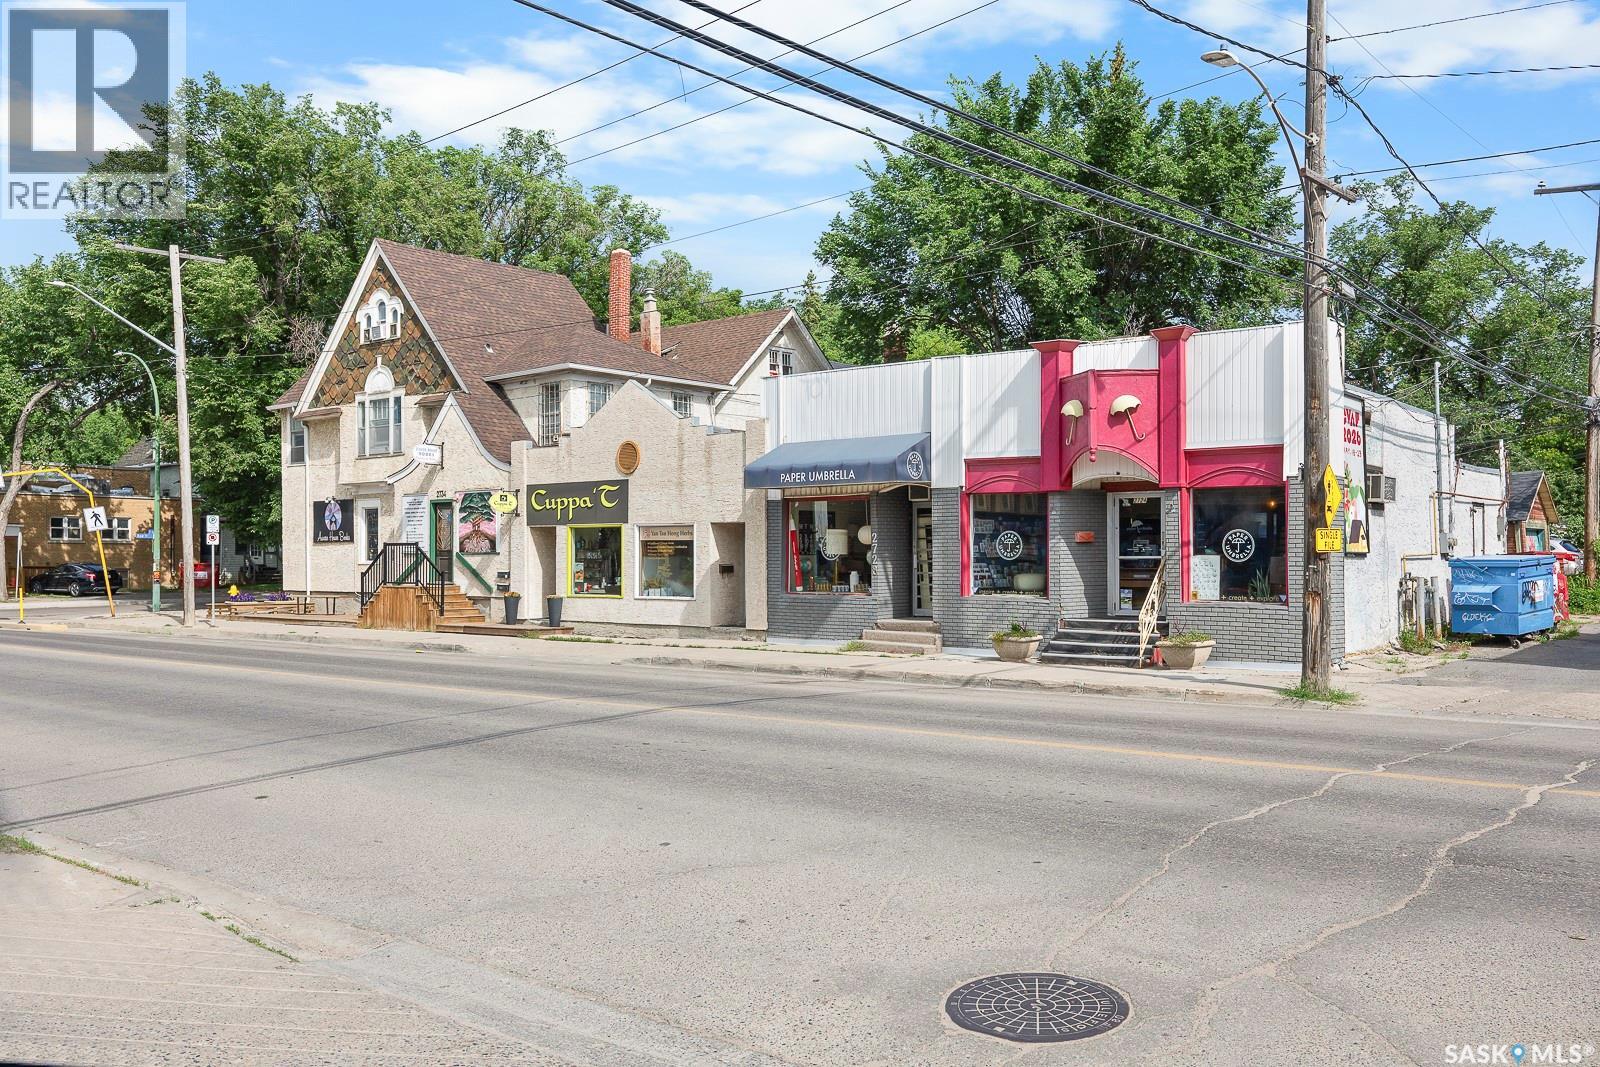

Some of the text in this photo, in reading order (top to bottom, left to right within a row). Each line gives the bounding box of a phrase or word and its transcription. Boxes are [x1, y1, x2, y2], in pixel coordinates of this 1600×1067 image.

[780, 469, 856, 483] PAPER UMBRELLA
[1228, 532, 1249, 541] PAPER
[1320, 531, 1338, 540] SINGLE
[1324, 541, 1335, 550] FILE
